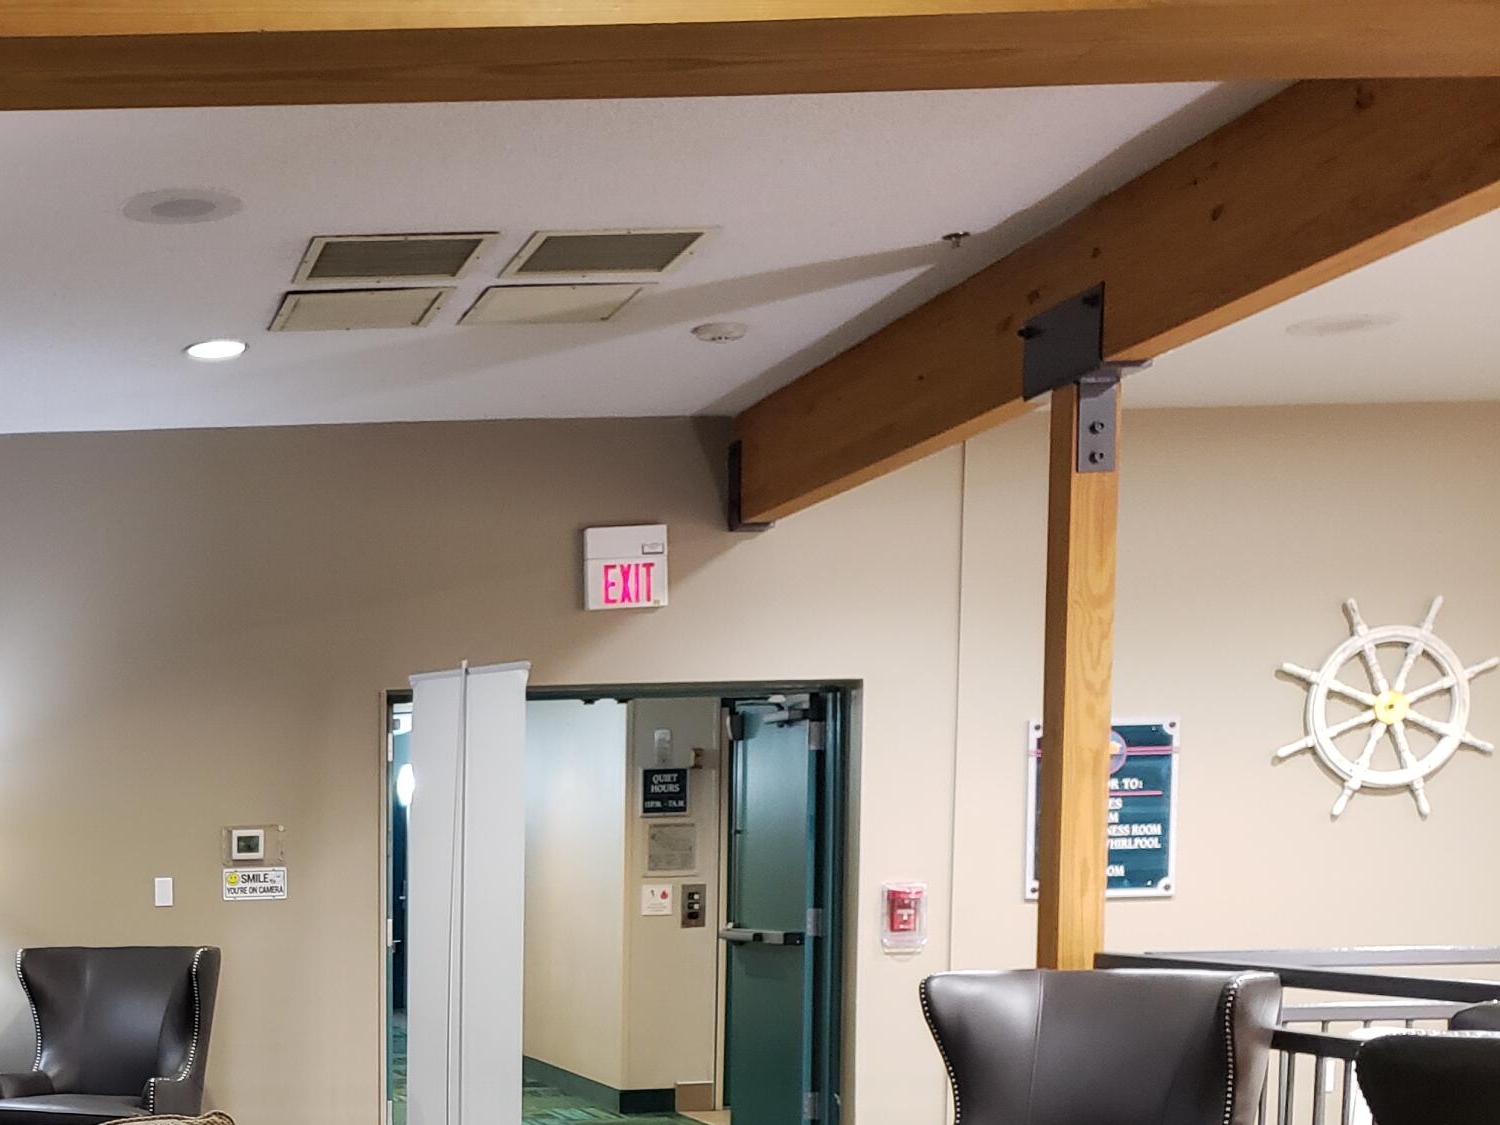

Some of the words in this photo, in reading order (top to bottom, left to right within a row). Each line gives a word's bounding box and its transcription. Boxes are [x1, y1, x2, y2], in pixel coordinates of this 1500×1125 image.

[603, 562, 655, 605] EXIT
[652, 773, 678, 784] QUIET
[1122, 778, 1143, 790] TO:
[651, 784, 680, 793] HOURS
[1107, 824, 1130, 836] NESS
[1131, 824, 1162, 836] ROOM
[1107, 837, 1162, 849] HIRLPOOL
[241, 873, 269, 884] SMILE
[227, 886, 248, 895] YOU'RE
[249, 886, 257, 894] ON
[258, 885, 284, 894] CAMERA
